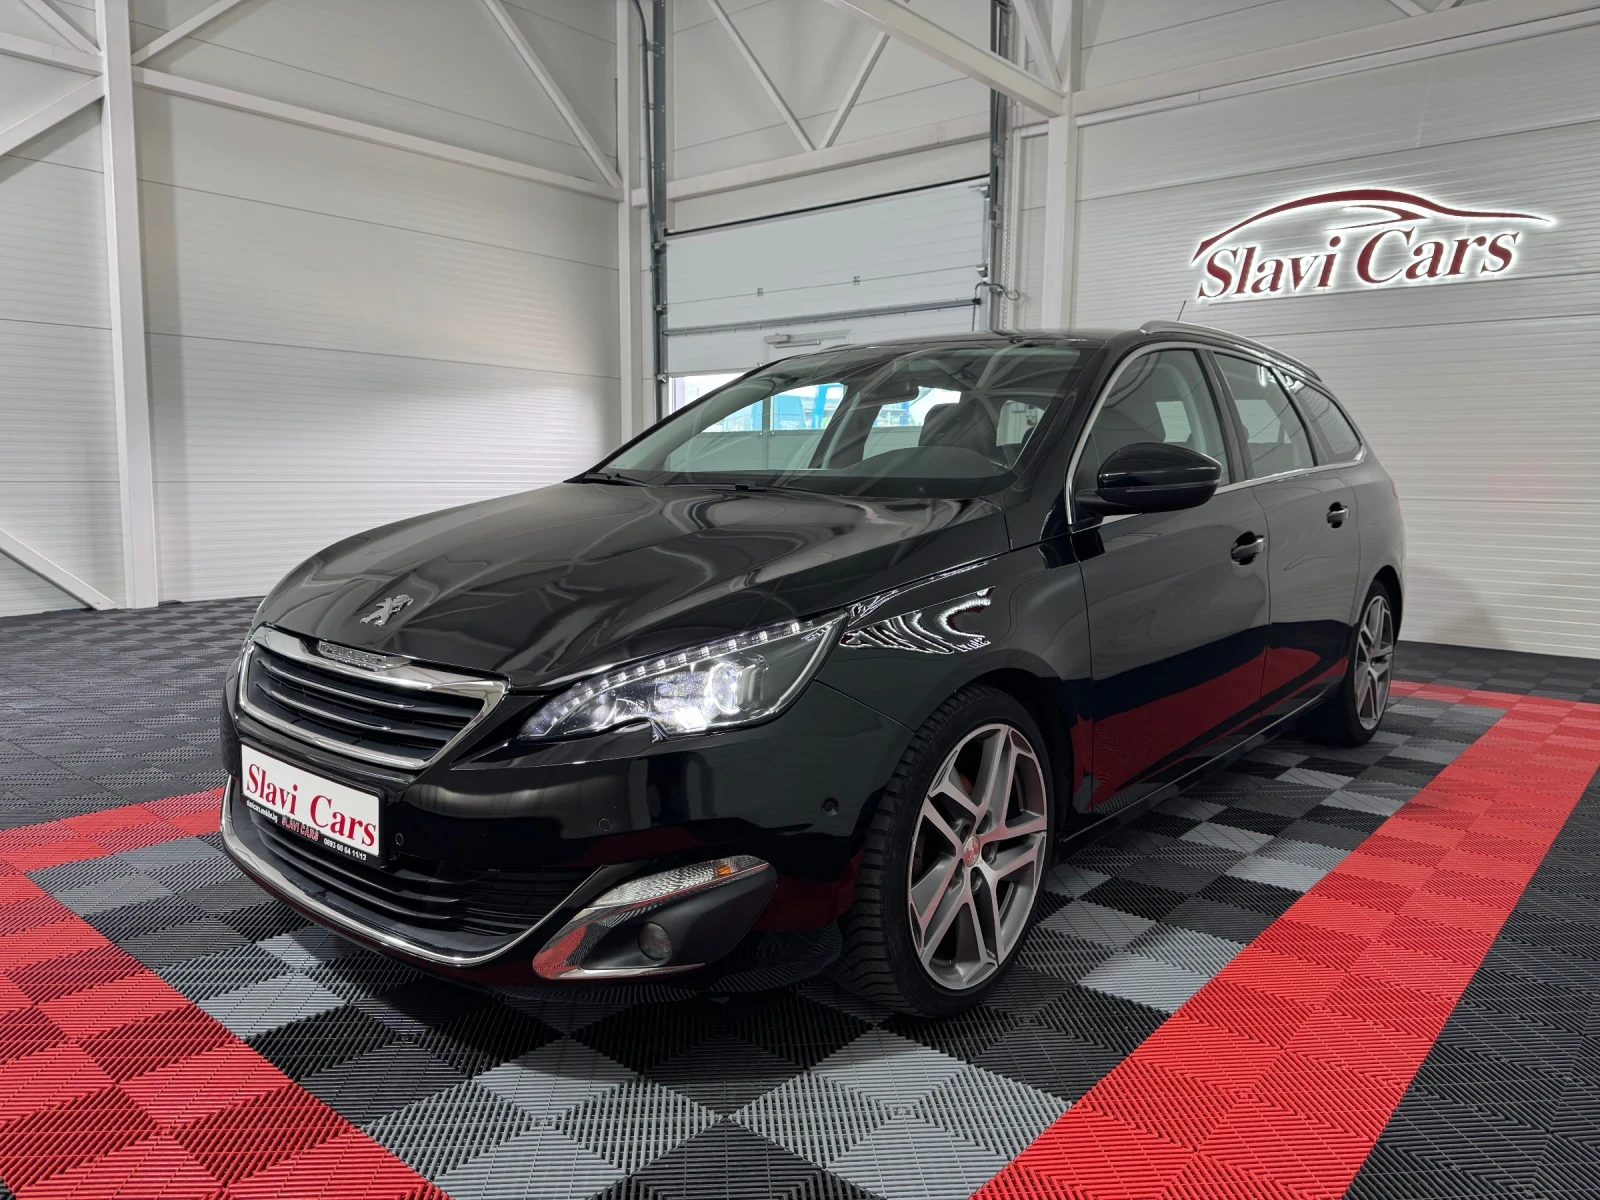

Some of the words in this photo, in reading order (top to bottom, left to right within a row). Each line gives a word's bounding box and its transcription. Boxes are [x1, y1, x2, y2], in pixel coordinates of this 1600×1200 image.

[1197, 236, 1341, 299] Slavi
[1357, 227, 1520, 284] Cars
[246, 763, 298, 816] Slavi
[310, 795, 377, 847] Cars
[281, 815, 300, 833] SLAVI
[300, 824, 320, 842] CARS
[352, 849, 367, 861] 11/12
